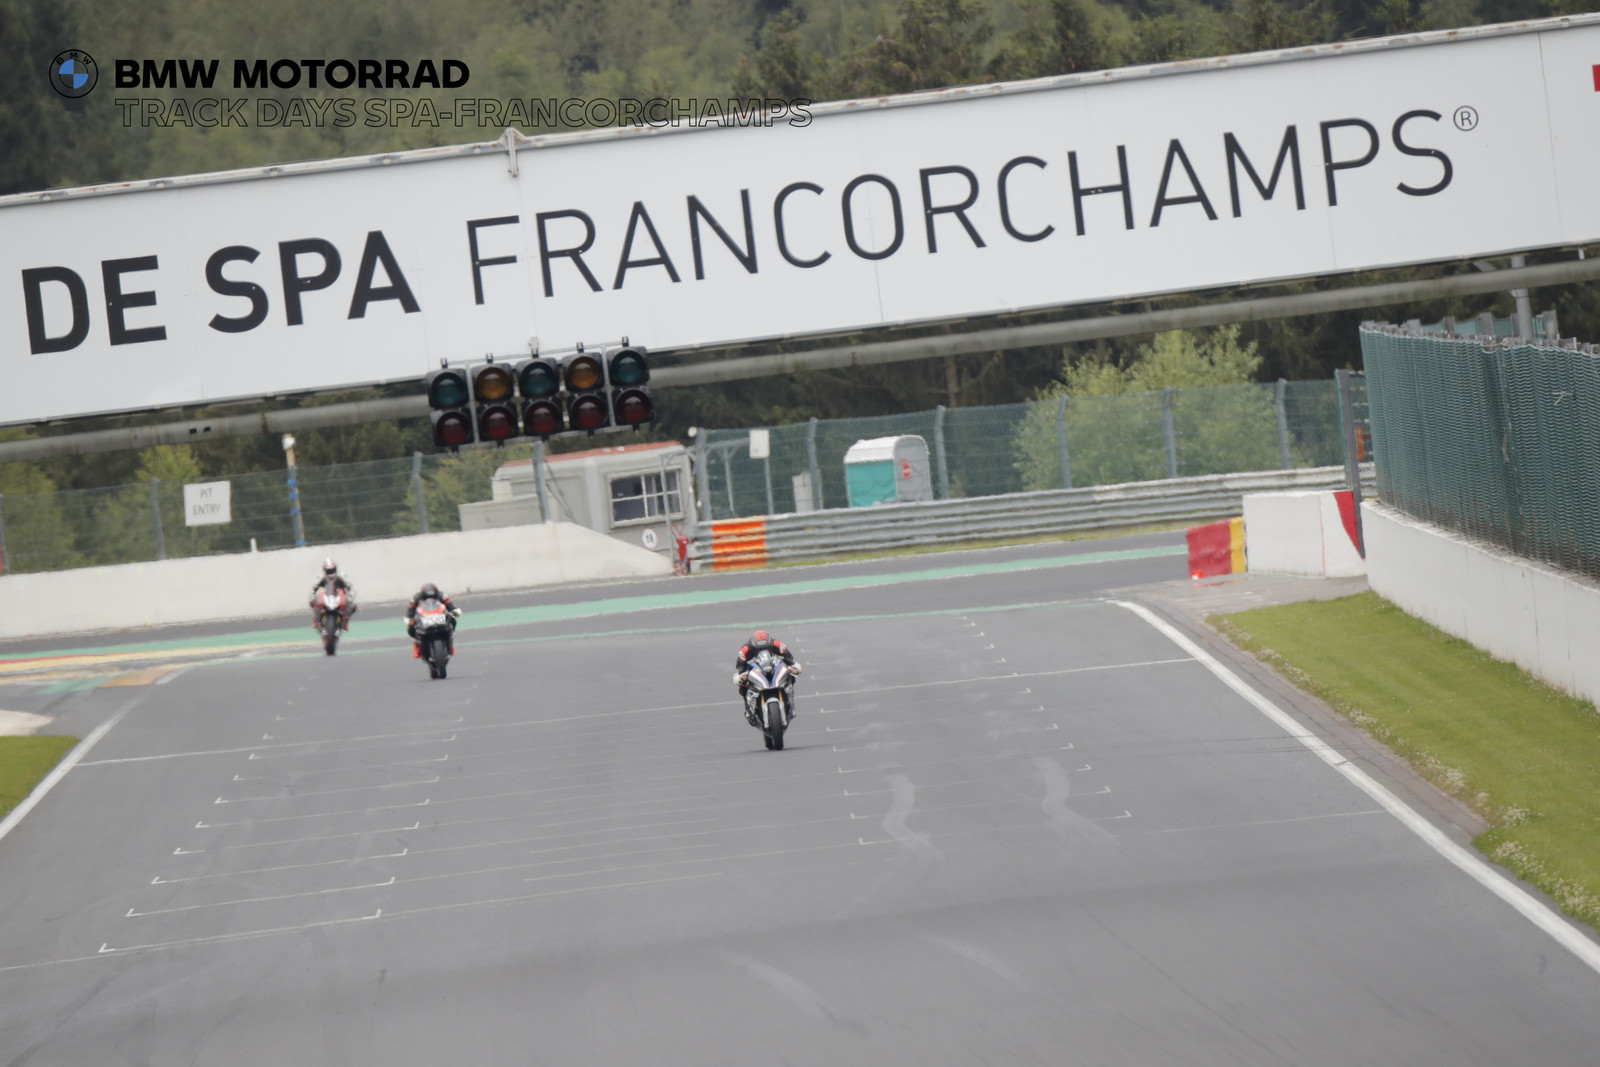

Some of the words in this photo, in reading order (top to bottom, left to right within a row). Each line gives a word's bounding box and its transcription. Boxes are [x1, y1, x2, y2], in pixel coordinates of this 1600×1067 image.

[21, 255, 167, 355] DE
[205, 231, 421, 334] SPA
[200, 487, 213, 500] PIT
[192, 503, 221, 516] ENTRY
